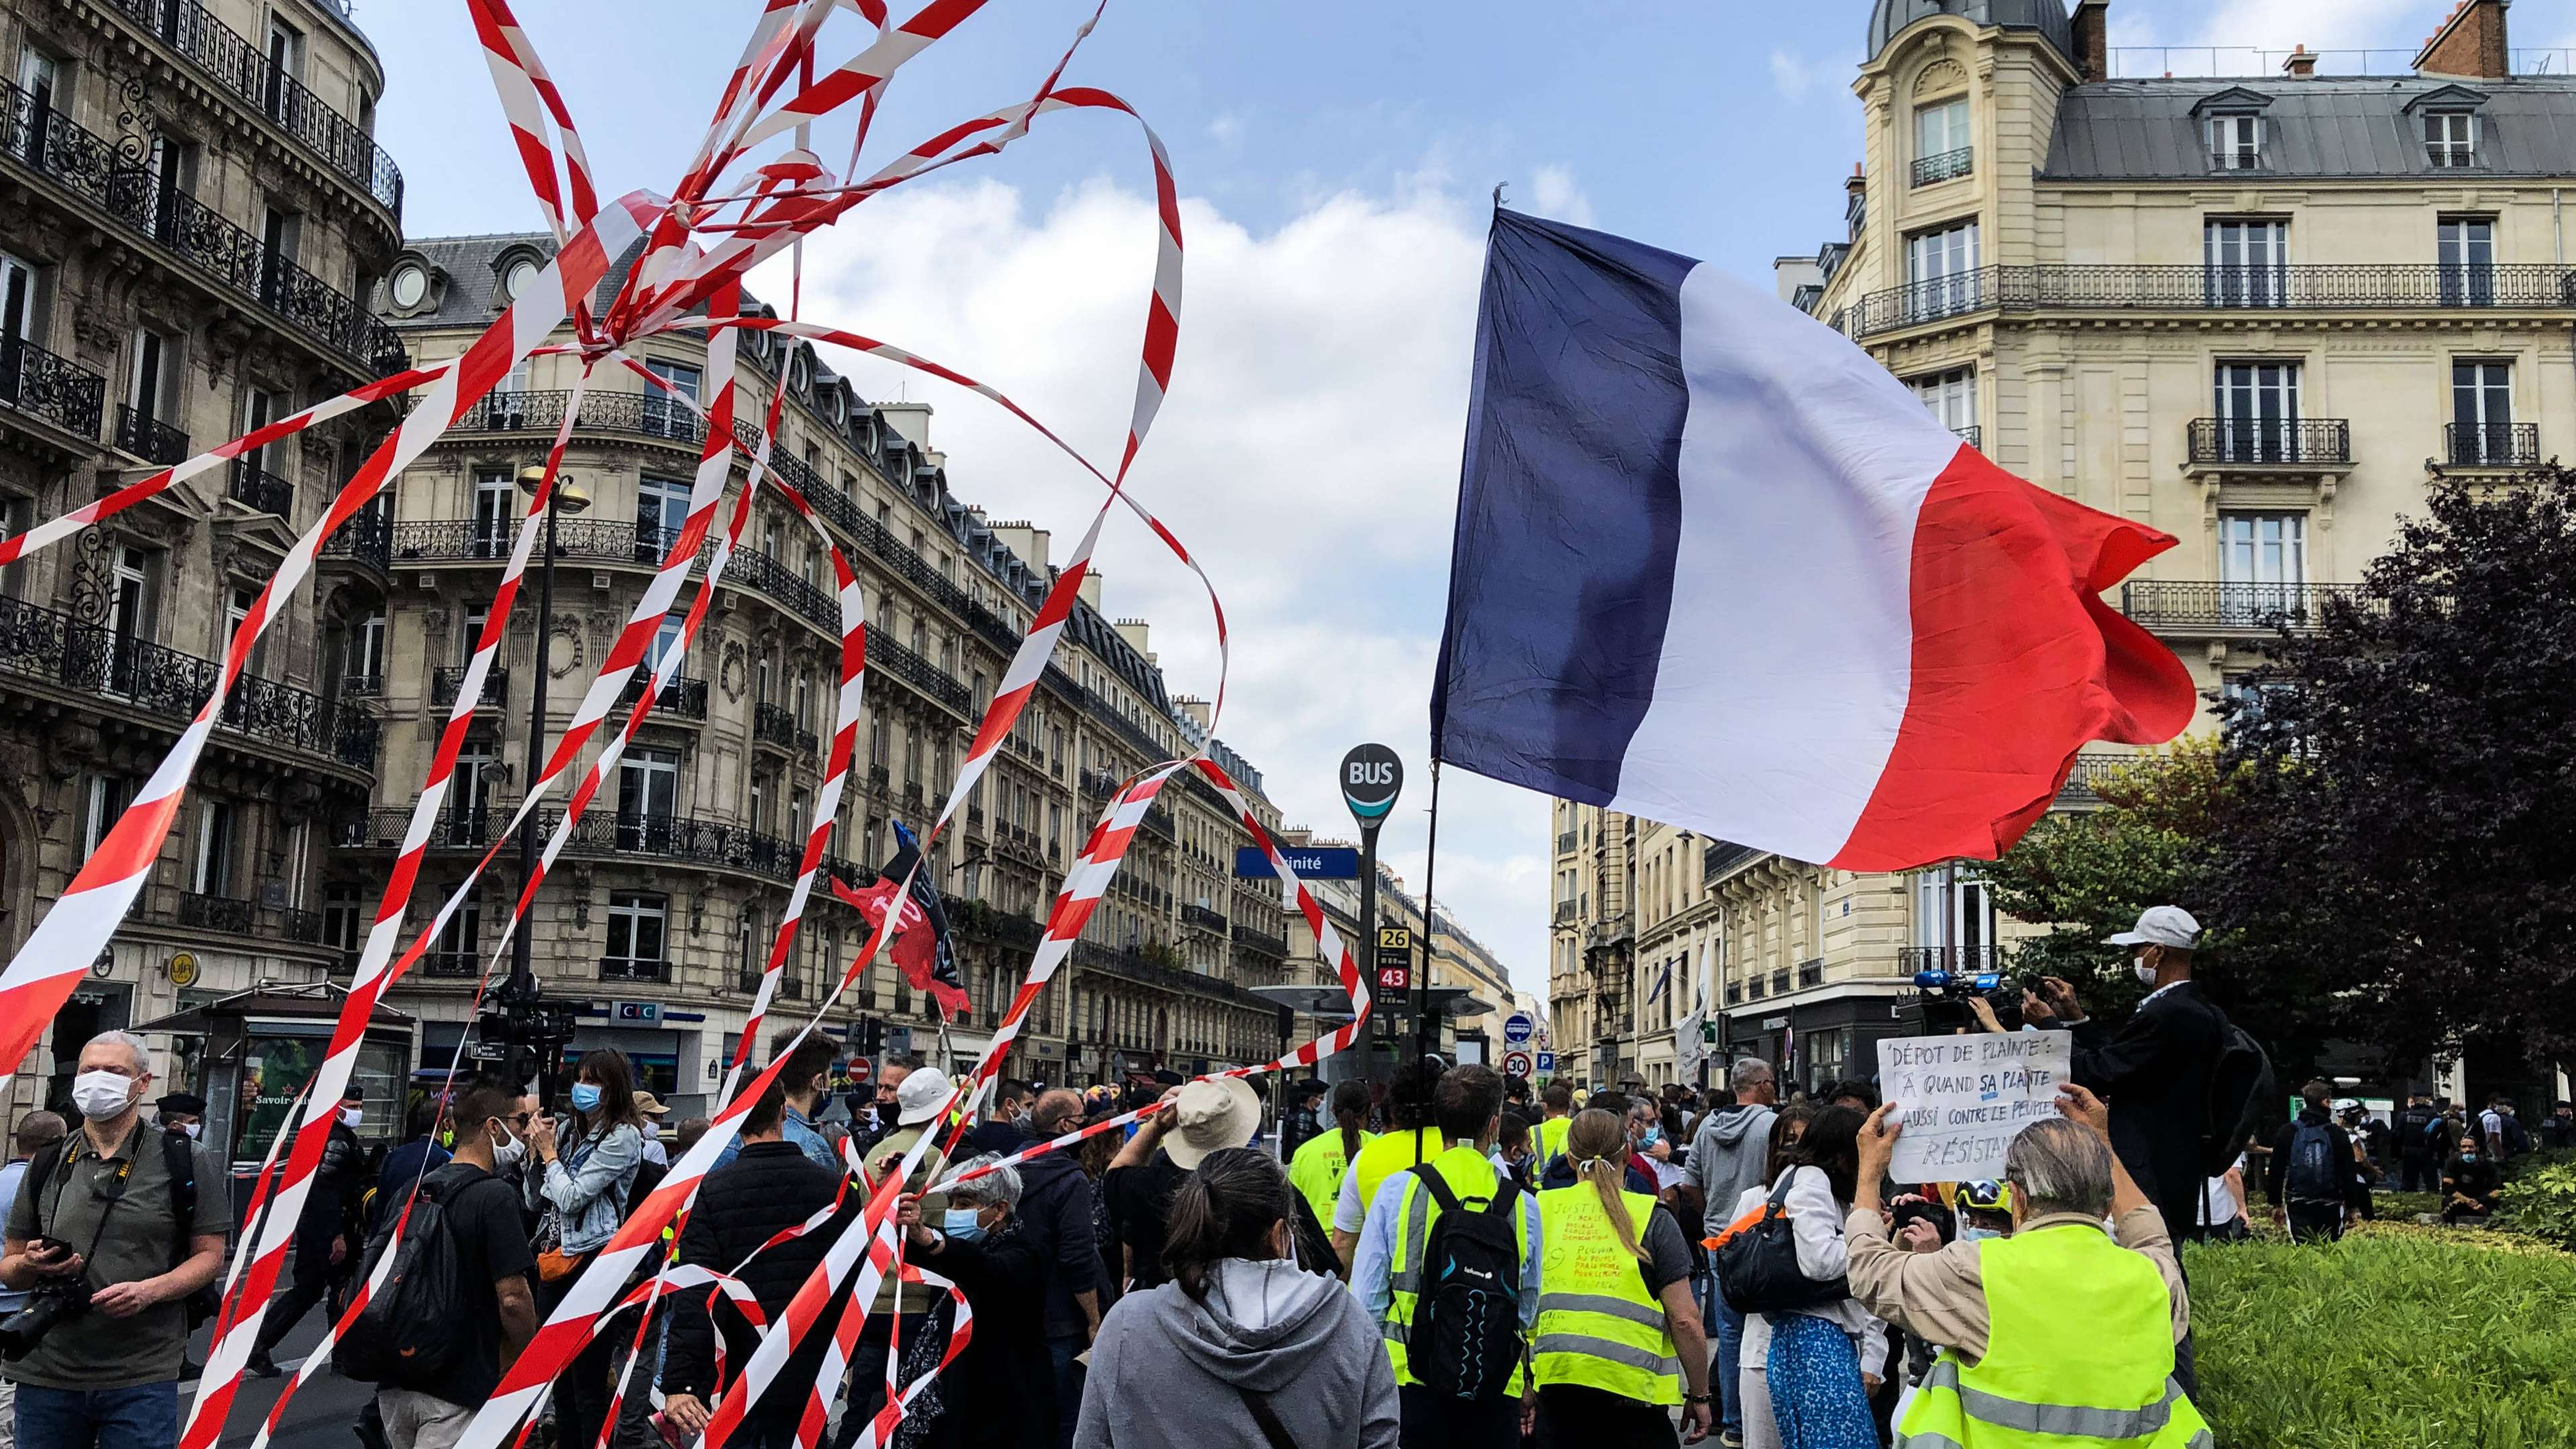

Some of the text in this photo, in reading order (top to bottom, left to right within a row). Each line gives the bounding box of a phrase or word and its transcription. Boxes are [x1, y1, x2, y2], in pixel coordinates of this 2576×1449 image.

[1350, 762, 1393, 784] BUS
[1284, 856, 1322, 869] inité
[1384, 930, 1405, 946] 26
[1382, 970, 1404, 986] 43
[623, 1004, 653, 1018] CIC
[1540, 1055, 1550, 1067] P
[1953, 1045, 1972, 1062] DE
[1509, 1059, 1526, 1072] 30
[1924, 1075, 1974, 1095] QUAND
[1980, 1075, 1996, 1092] SA
[1949, 1108, 1987, 1125] CONTRE
[1991, 1106, 2006, 1121] LE
[1554, 1203, 1606, 1214] JUSTIC
